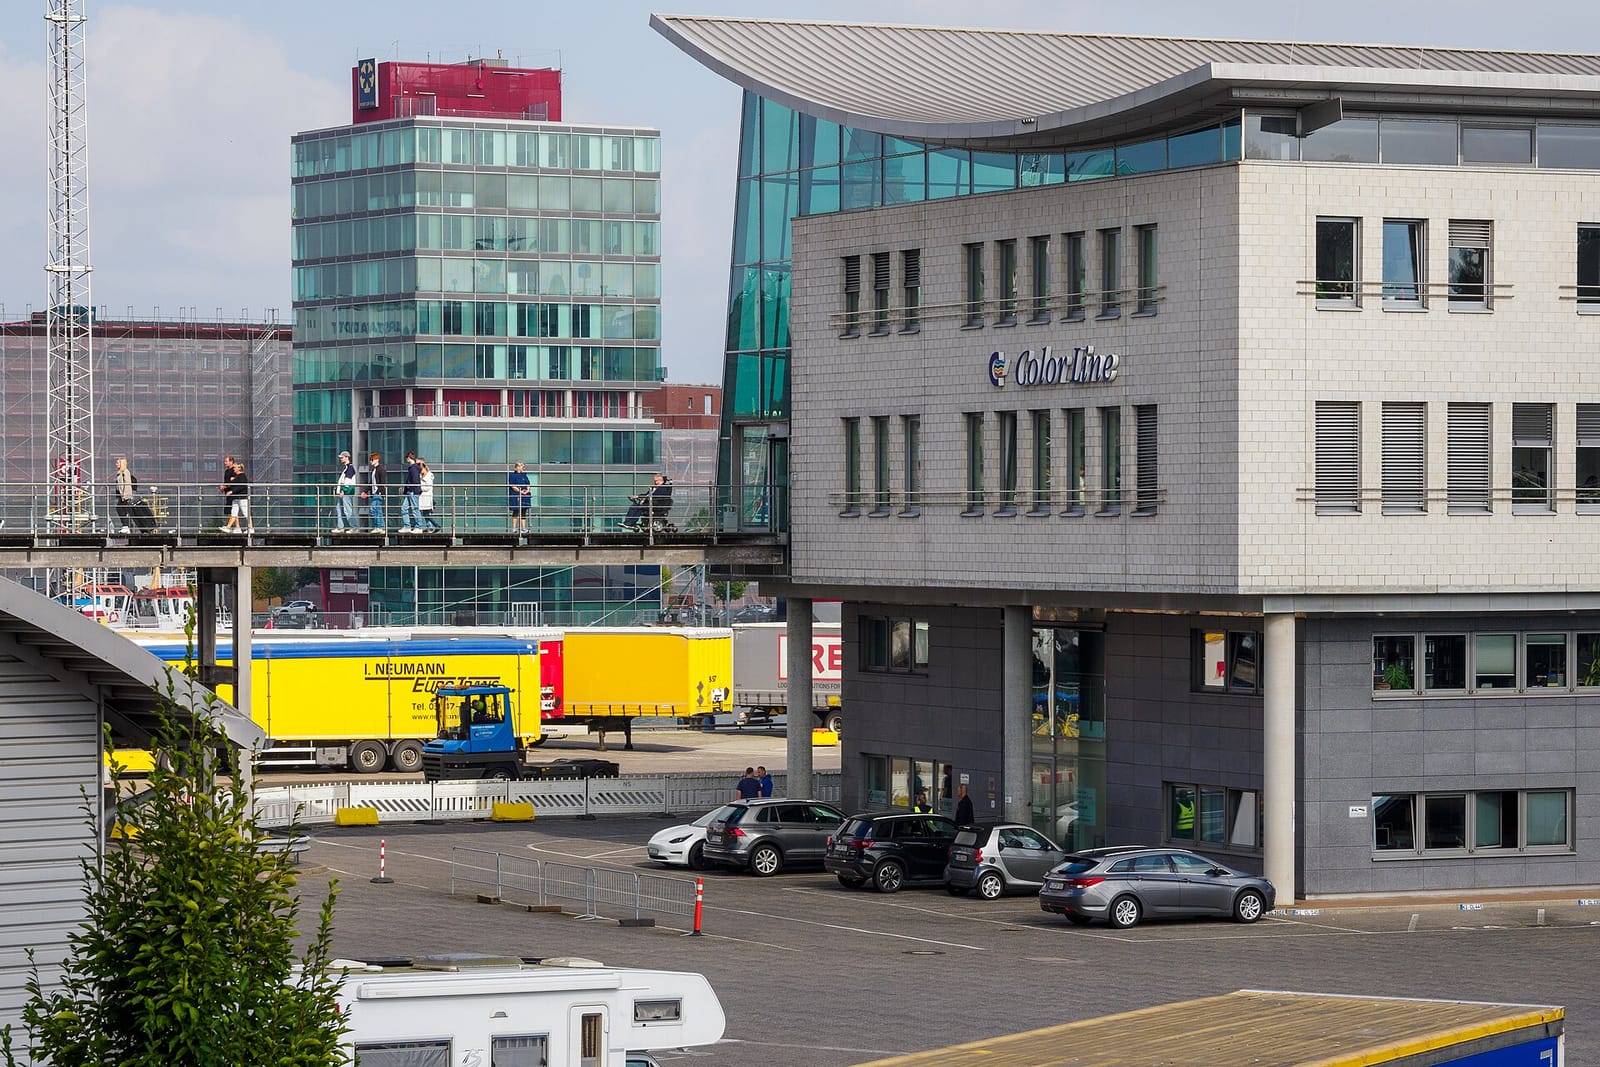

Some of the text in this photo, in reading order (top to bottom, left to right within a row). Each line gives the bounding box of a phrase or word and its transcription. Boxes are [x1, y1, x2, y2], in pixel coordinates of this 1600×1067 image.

[1015, 345, 1119, 385] Color Line
[375, 663, 445, 675] NEUMANN
[811, 644, 842, 674] RE
[411, 702, 427, 711] Tel.
